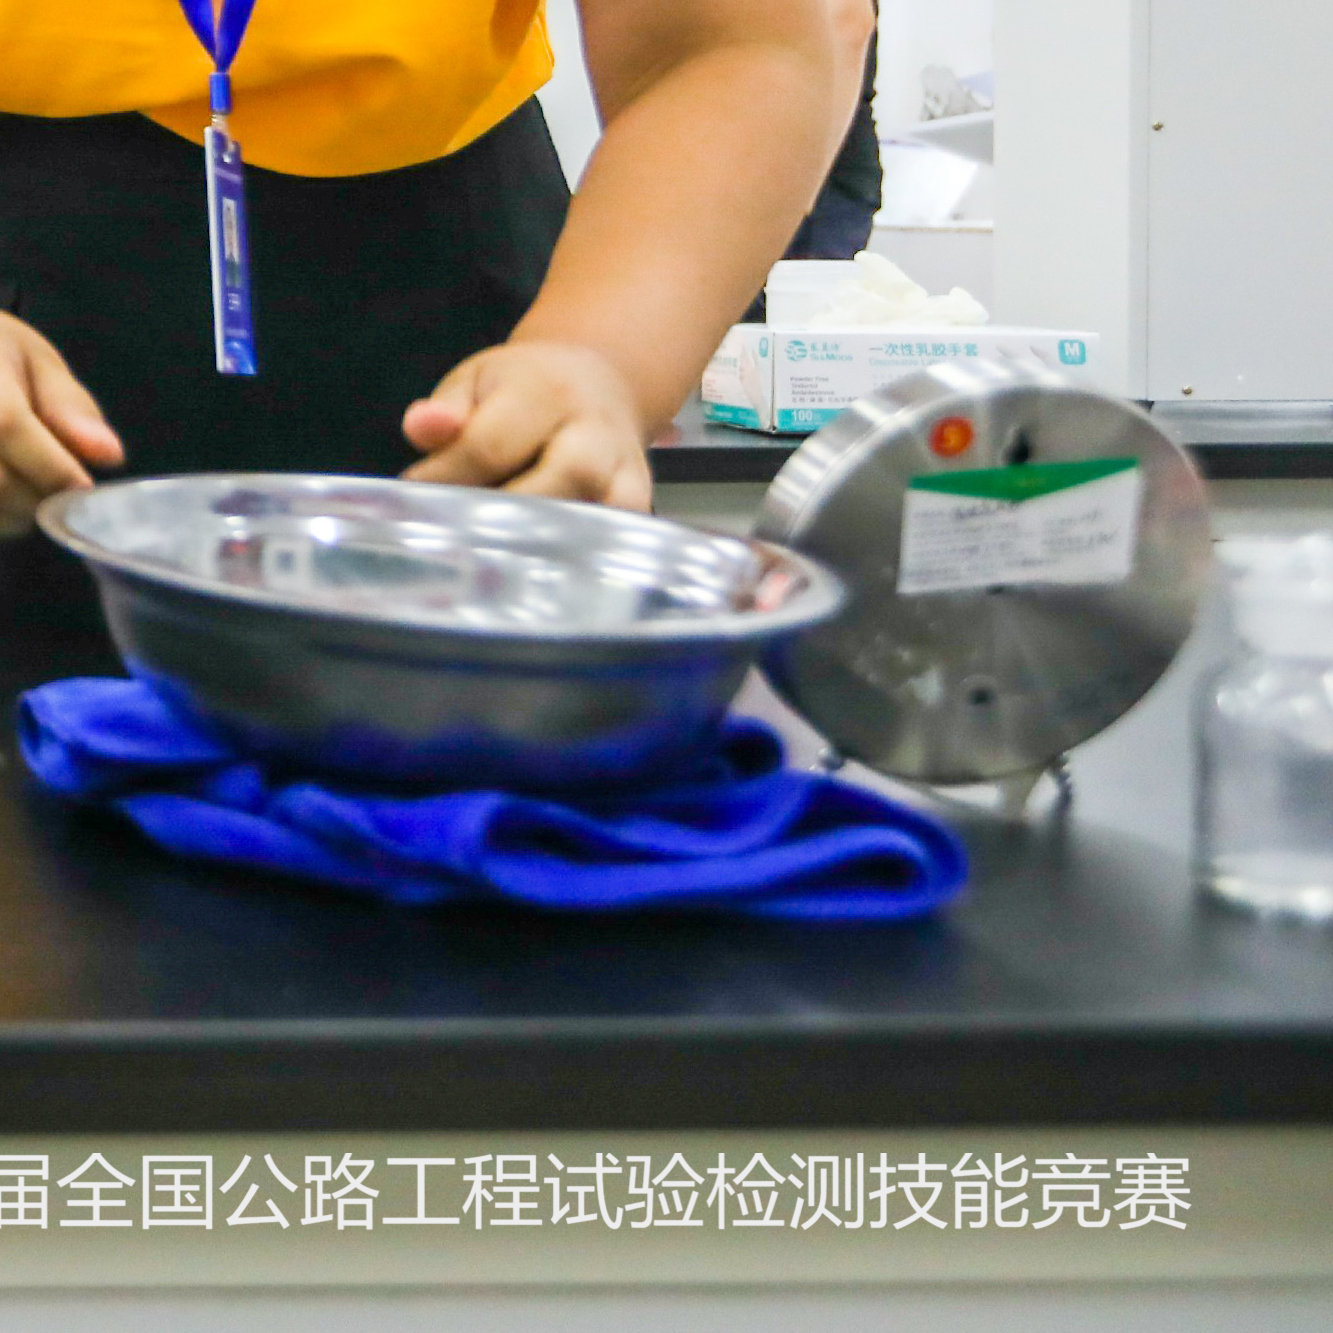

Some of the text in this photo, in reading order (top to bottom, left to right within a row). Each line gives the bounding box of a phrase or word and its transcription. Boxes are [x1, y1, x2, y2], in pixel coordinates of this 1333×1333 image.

[868, 342, 979, 357] 一次性乳胶手套
[1064, 341, 1080, 357] M
[792, 409, 812, 422] 100
